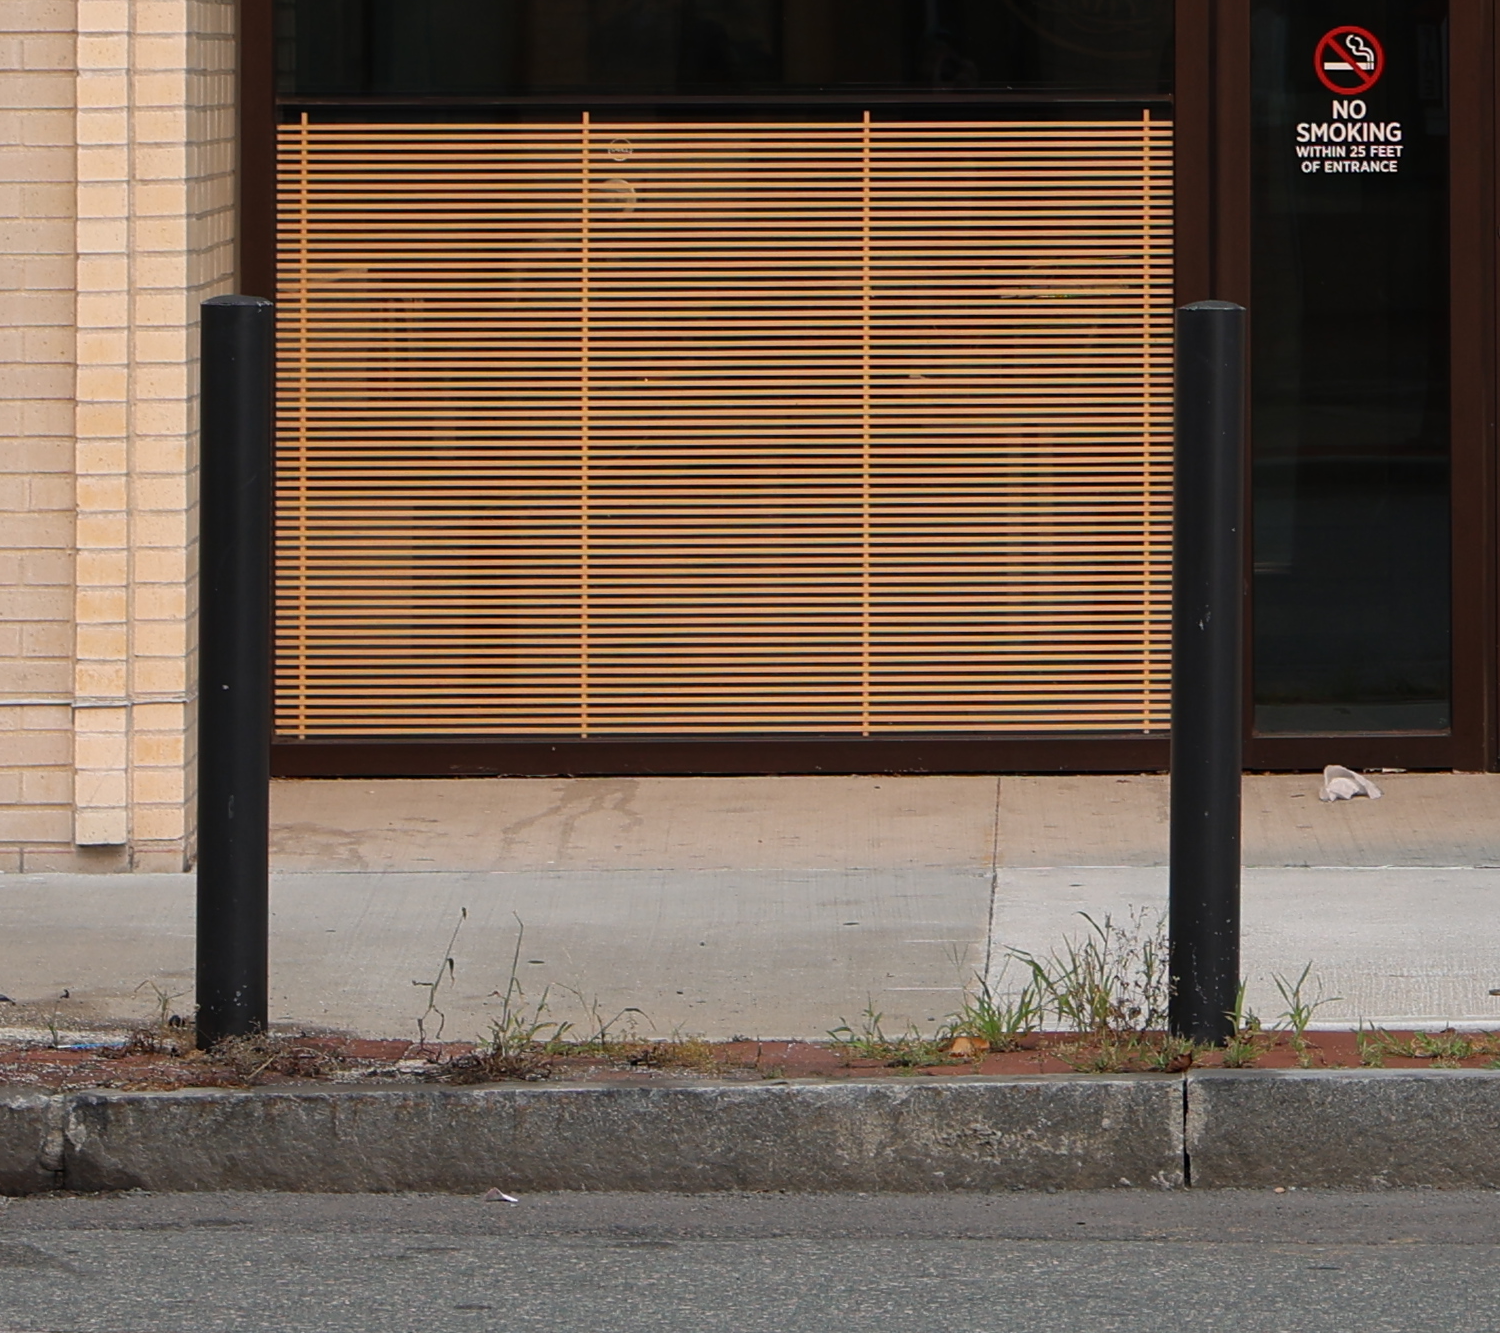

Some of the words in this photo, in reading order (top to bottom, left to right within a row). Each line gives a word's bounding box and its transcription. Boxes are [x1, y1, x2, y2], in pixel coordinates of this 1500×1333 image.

[1332, 99, 1367, 119] NO
[1296, 122, 1402, 143] SMOKING
[1295, 146, 1346, 158] WITHIN
[1350, 145, 1367, 158] 25
[1369, 145, 1404, 157] FEET
[1301, 161, 1321, 173] OF
[1324, 160, 1398, 173] ENTRANCE
